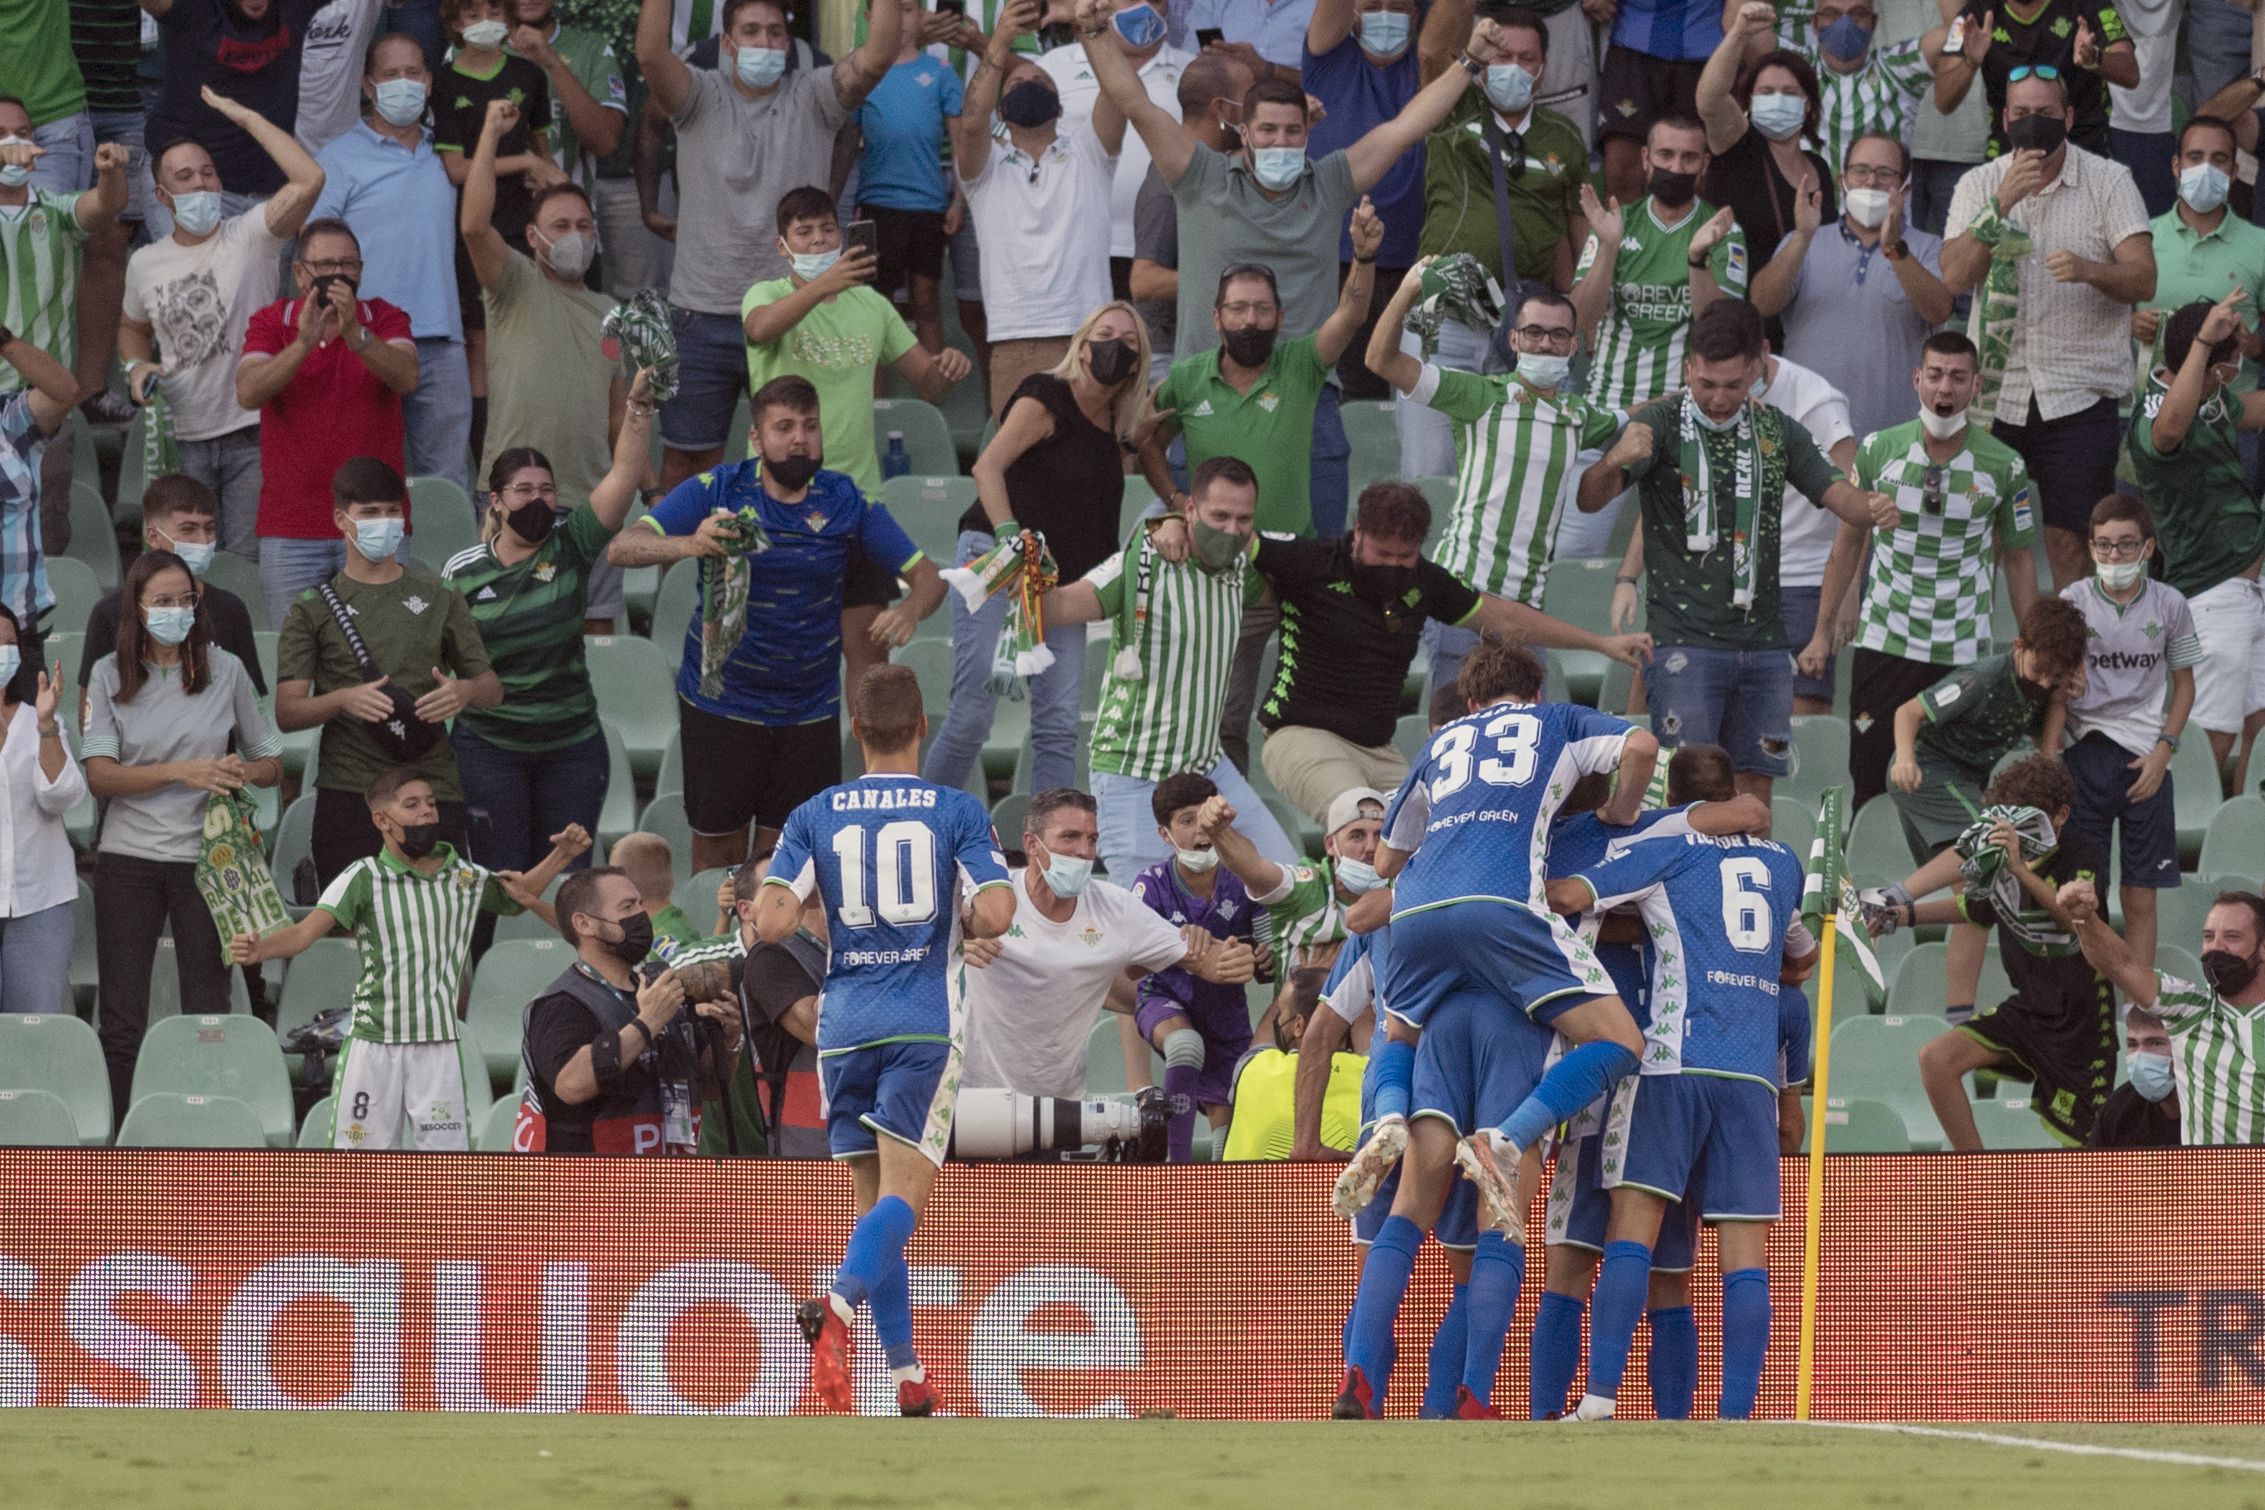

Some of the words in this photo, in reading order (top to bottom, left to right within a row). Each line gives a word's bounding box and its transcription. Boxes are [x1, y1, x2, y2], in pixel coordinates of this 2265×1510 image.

[1431, 714, 1543, 804] 33
[833, 788, 937, 811] CANALES
[833, 821, 938, 929] 10
[1719, 857, 1772, 955] 6
[843, 951, 900, 966] FOREVER
[1707, 971, 1756, 986] FOREVER
[353, 1091, 370, 1120] 8
